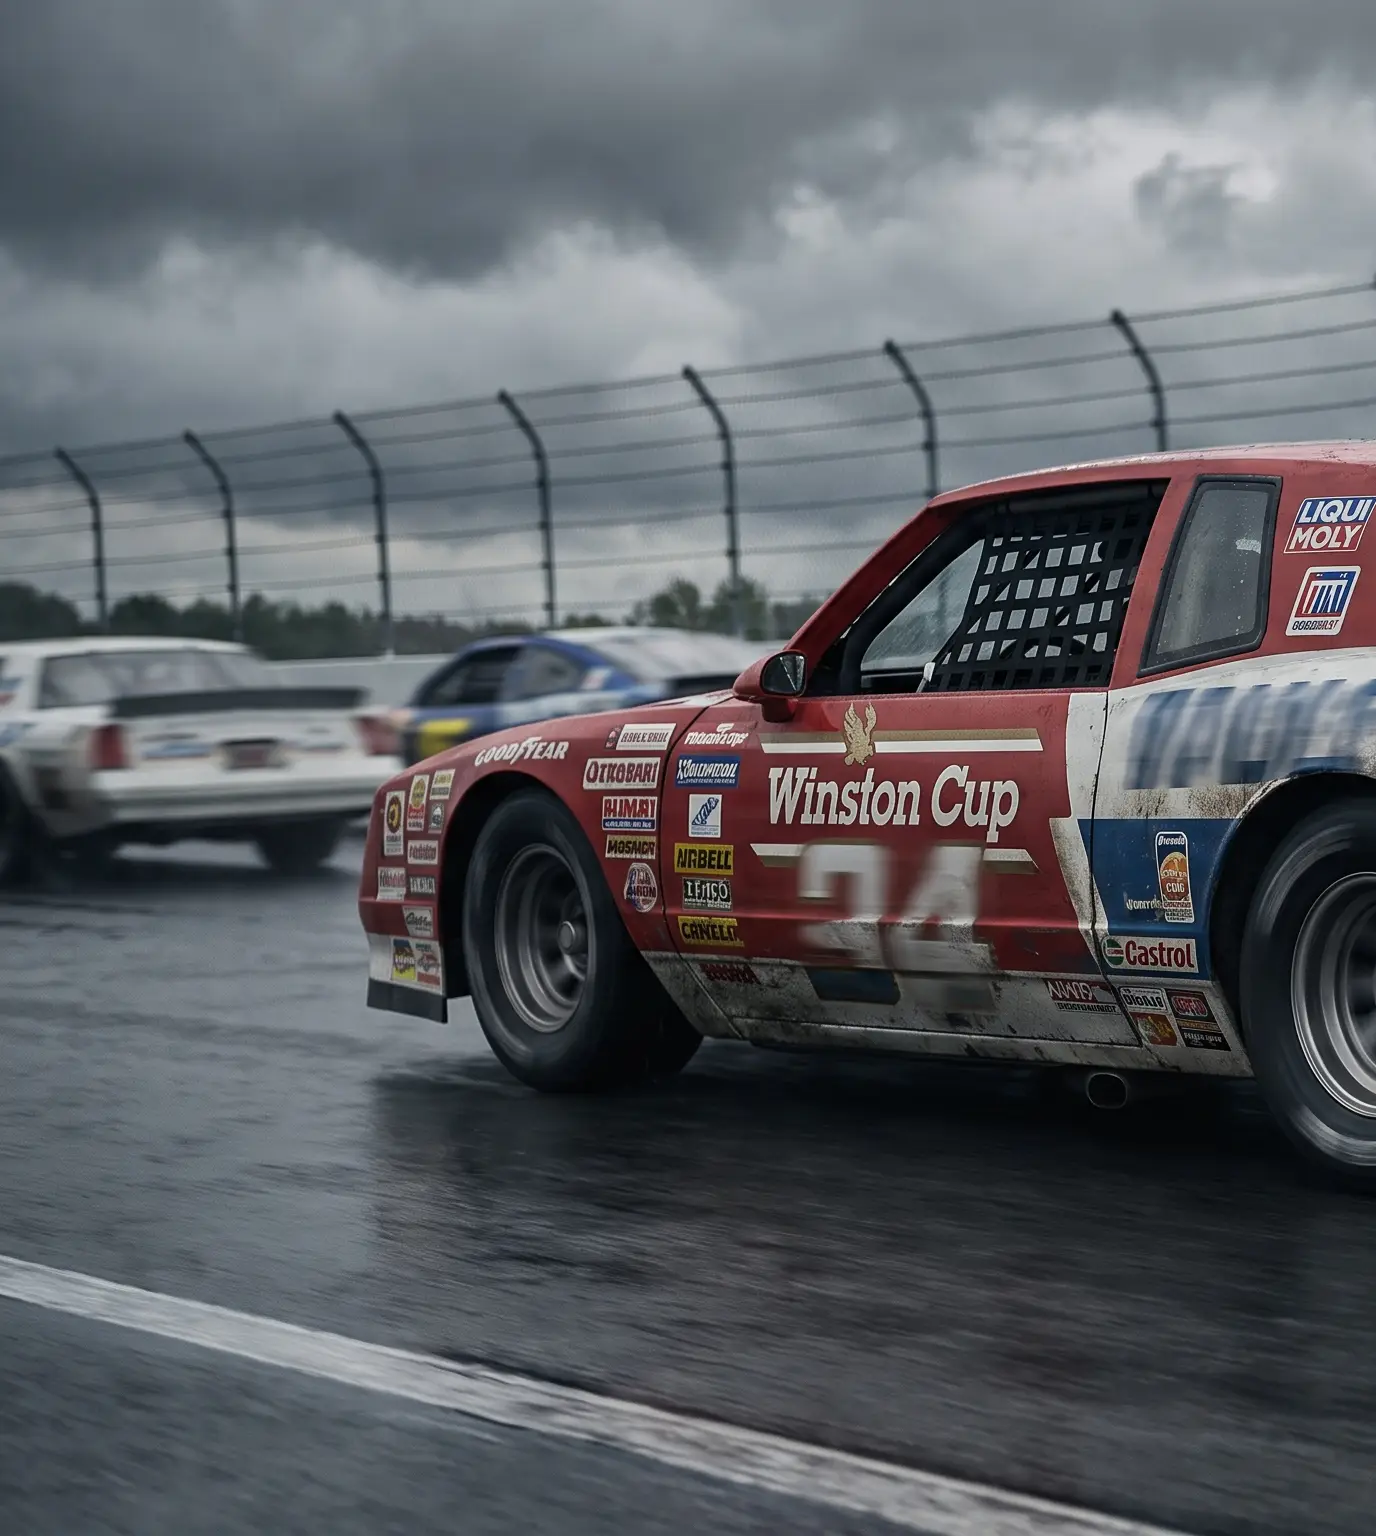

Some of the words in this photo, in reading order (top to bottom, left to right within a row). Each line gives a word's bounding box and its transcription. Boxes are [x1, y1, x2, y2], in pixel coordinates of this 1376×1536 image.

[1298, 499, 1373, 523] LIQUI
[1289, 524, 1363, 550] MOLY
[474, 735, 570, 767] GOODYEAR
[767, 766, 921, 826] Winston
[931, 764, 1020, 843] Cup
[1125, 940, 1195, 968] Castrol
